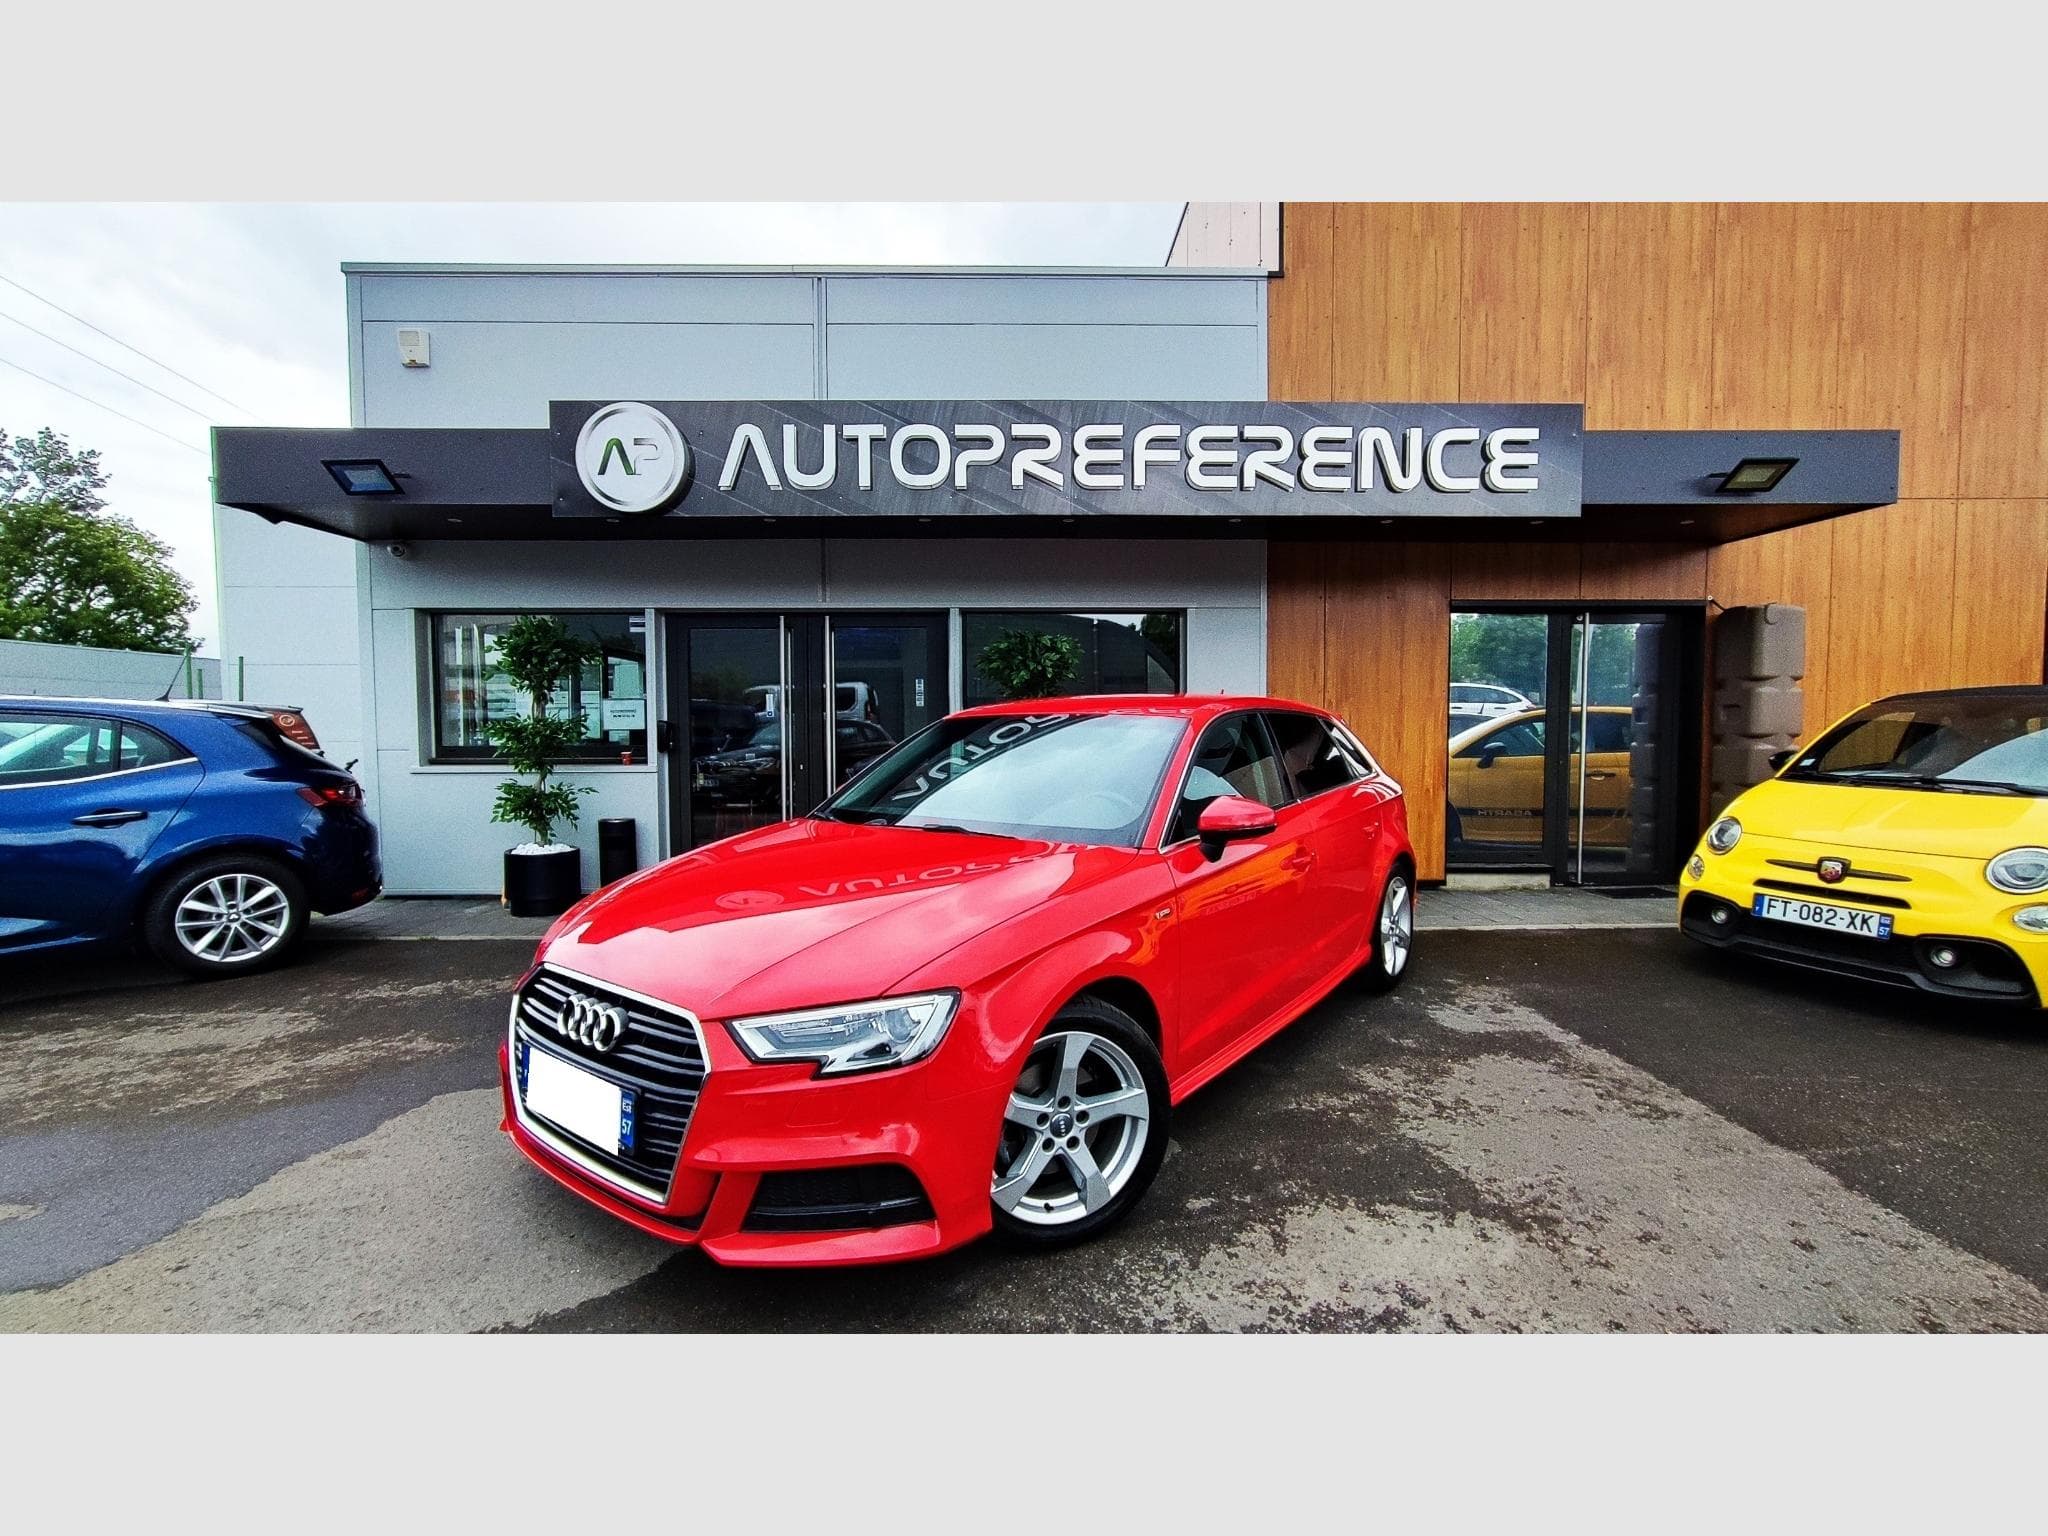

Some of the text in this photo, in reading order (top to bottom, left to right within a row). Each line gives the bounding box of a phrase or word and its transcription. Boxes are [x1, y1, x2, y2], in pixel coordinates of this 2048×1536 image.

[597, 437, 661, 476] AP
[718, 423, 1541, 492] AUTOPREFERENCE
[1766, 898, 1874, 933] FT-082-XK
[1879, 926, 1890, 936] 57
[621, 1118, 632, 1136] 57
